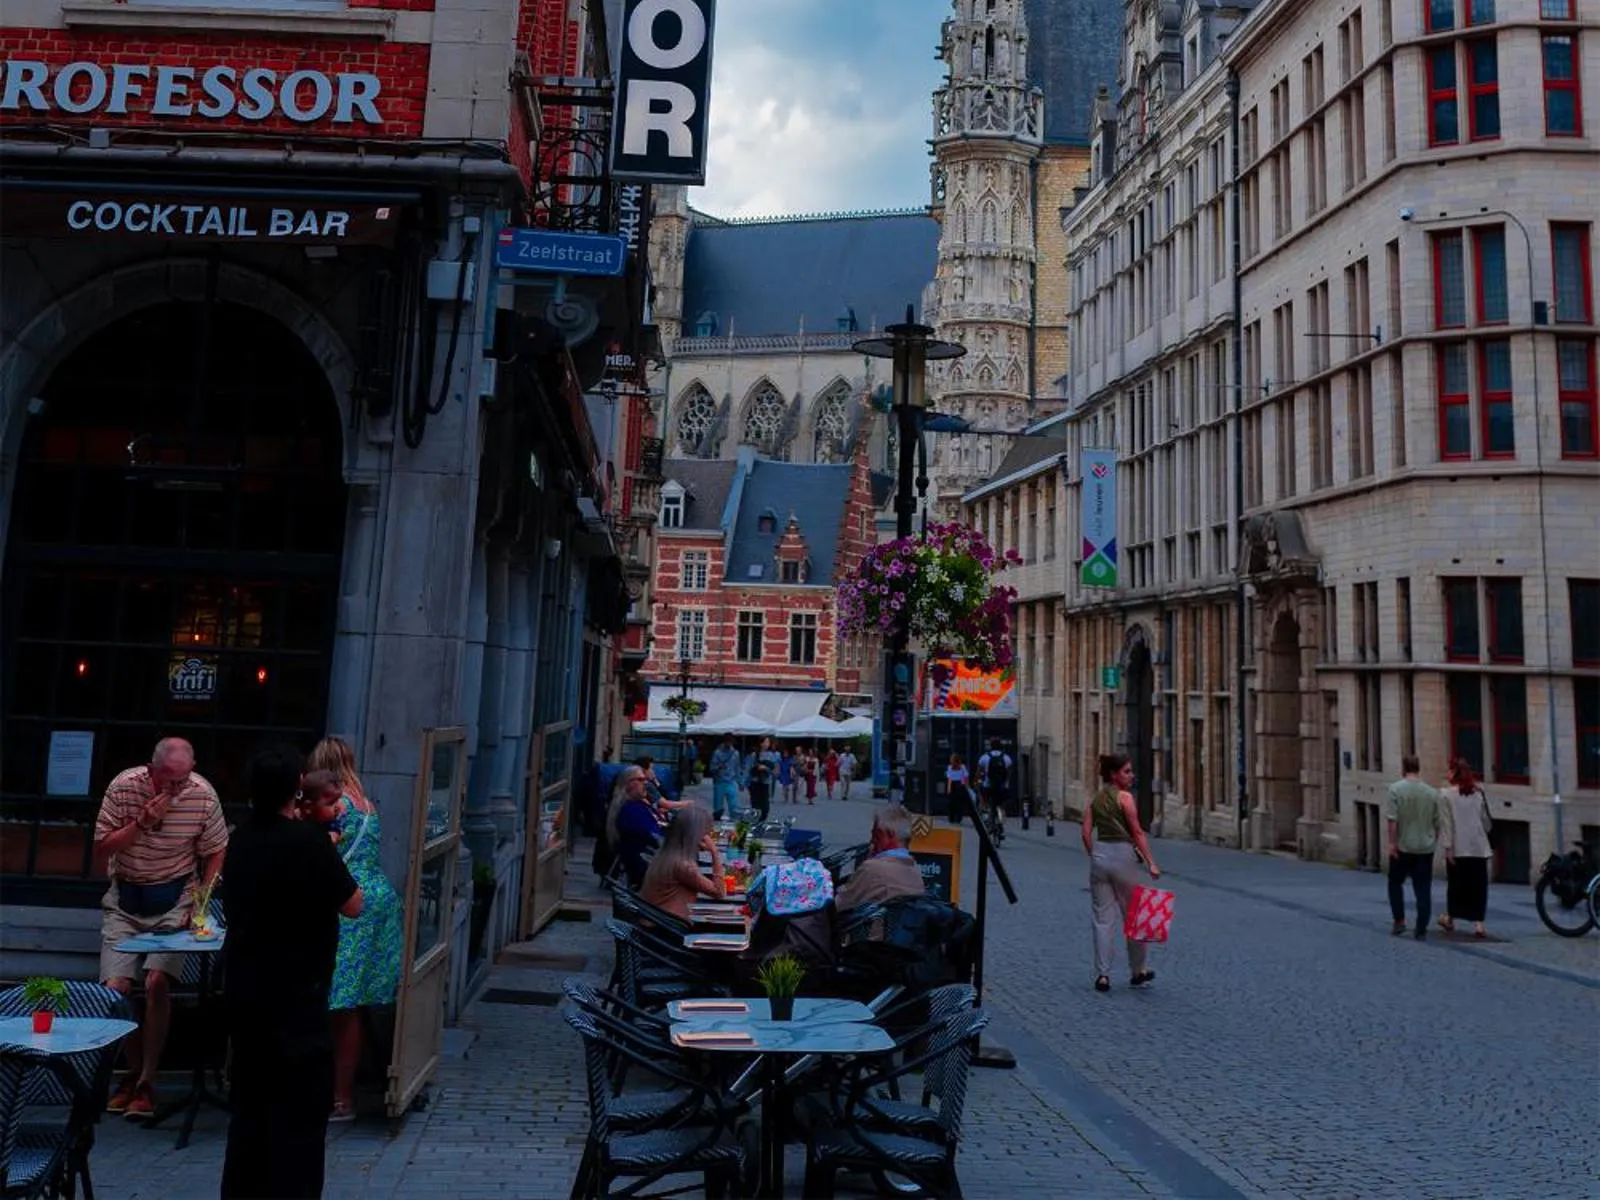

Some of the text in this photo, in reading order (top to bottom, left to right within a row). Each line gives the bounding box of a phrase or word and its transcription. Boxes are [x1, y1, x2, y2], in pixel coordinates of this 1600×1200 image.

[0, 59, 384, 124] ROFESSOR
[66, 200, 350, 237] COCKTAIL BAR
[518, 240, 613, 264] Zeelstraat
